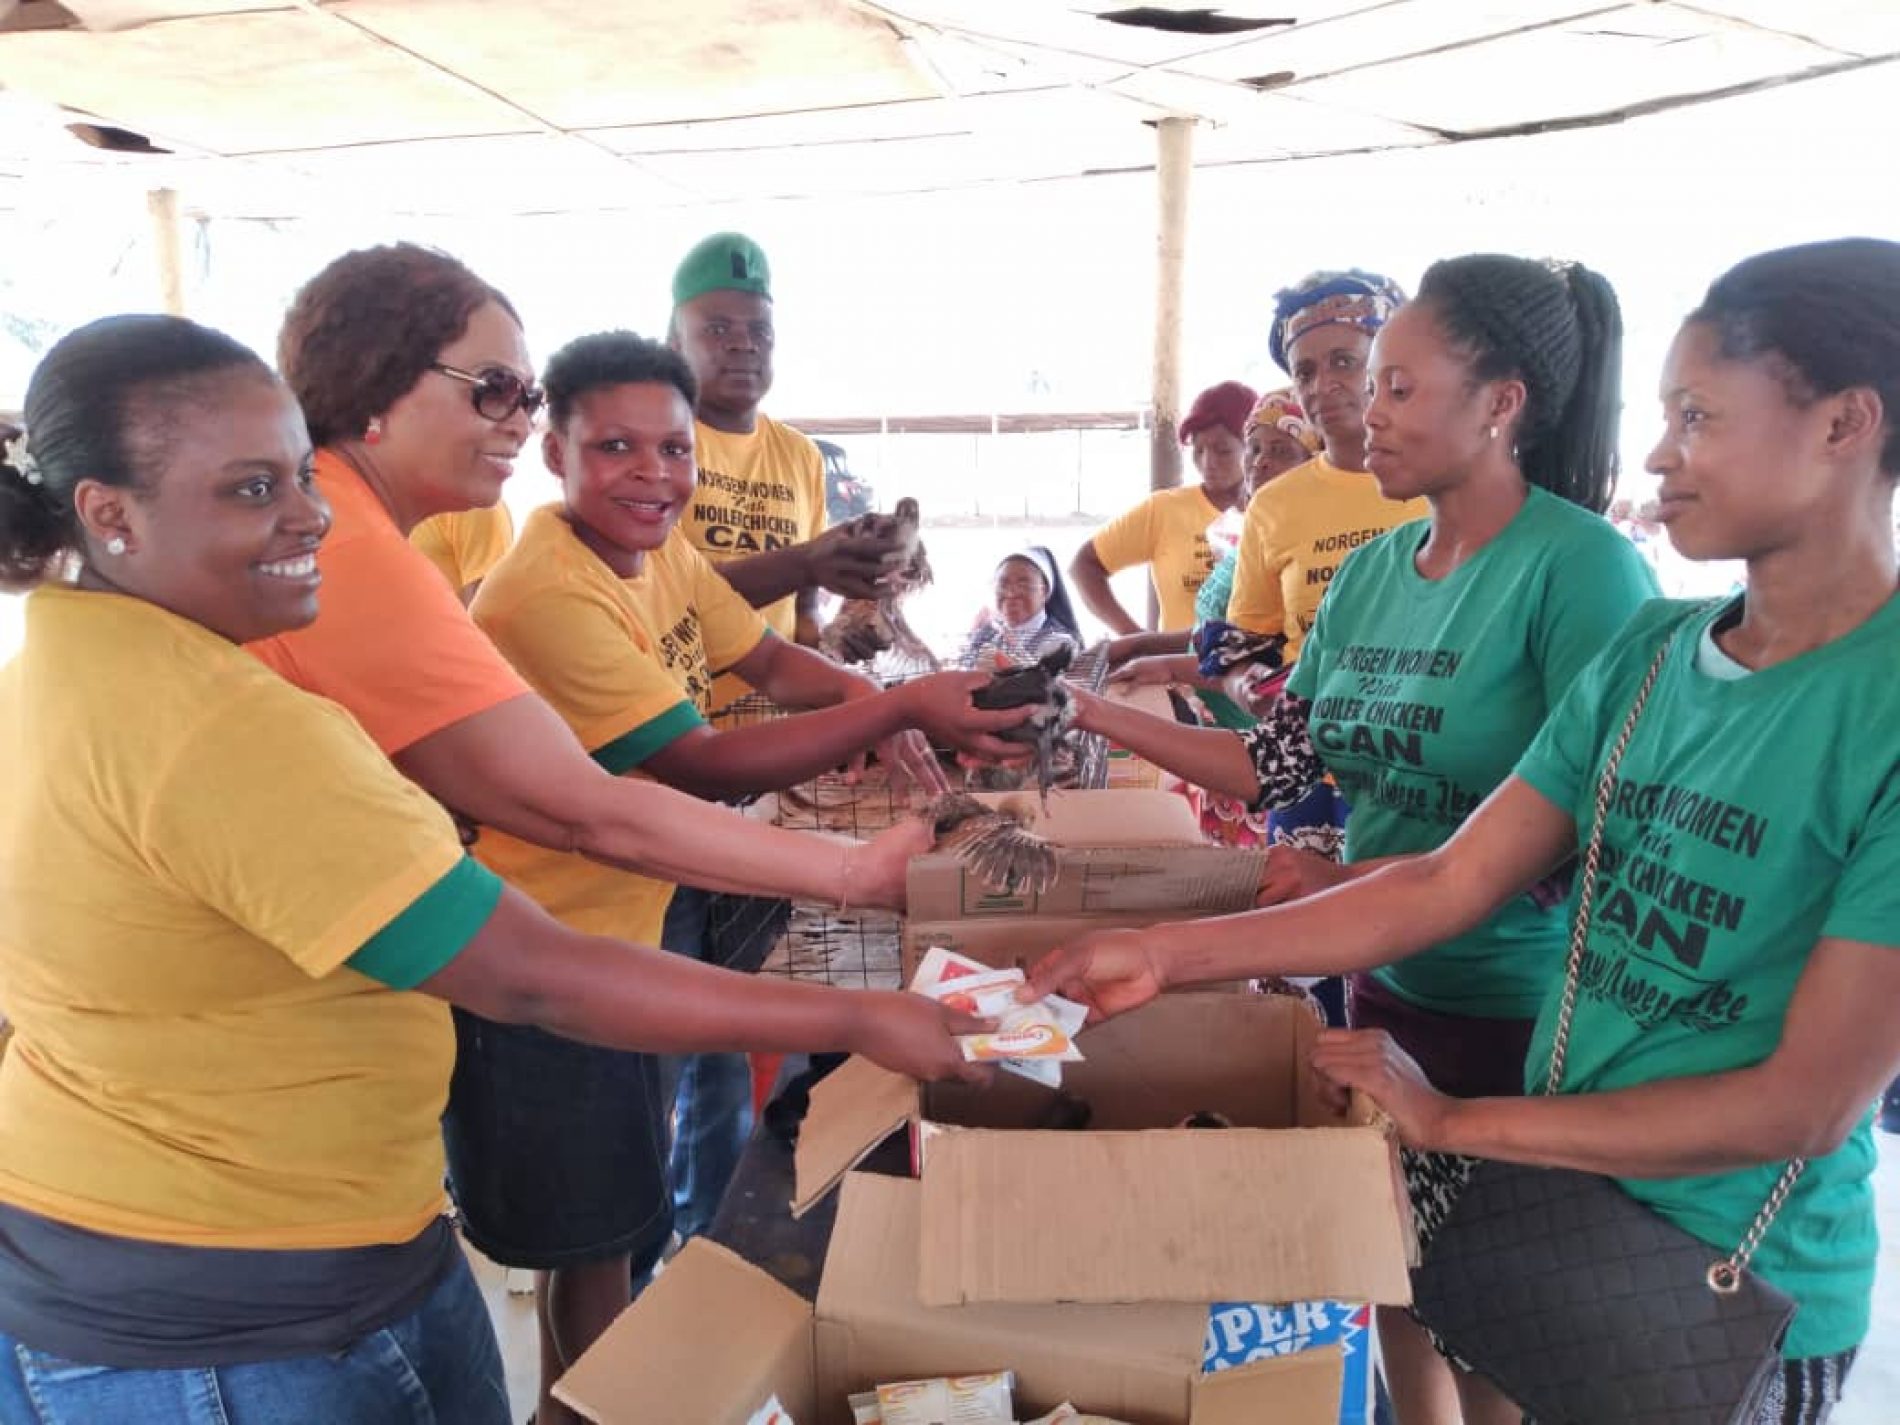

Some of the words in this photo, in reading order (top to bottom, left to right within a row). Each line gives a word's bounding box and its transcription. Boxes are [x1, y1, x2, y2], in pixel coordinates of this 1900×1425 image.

[705, 525, 791, 552] CAN
[1317, 723, 1424, 767] CAN
[1660, 784, 1769, 859] WOMEN
[1596, 879, 1711, 970] AN
